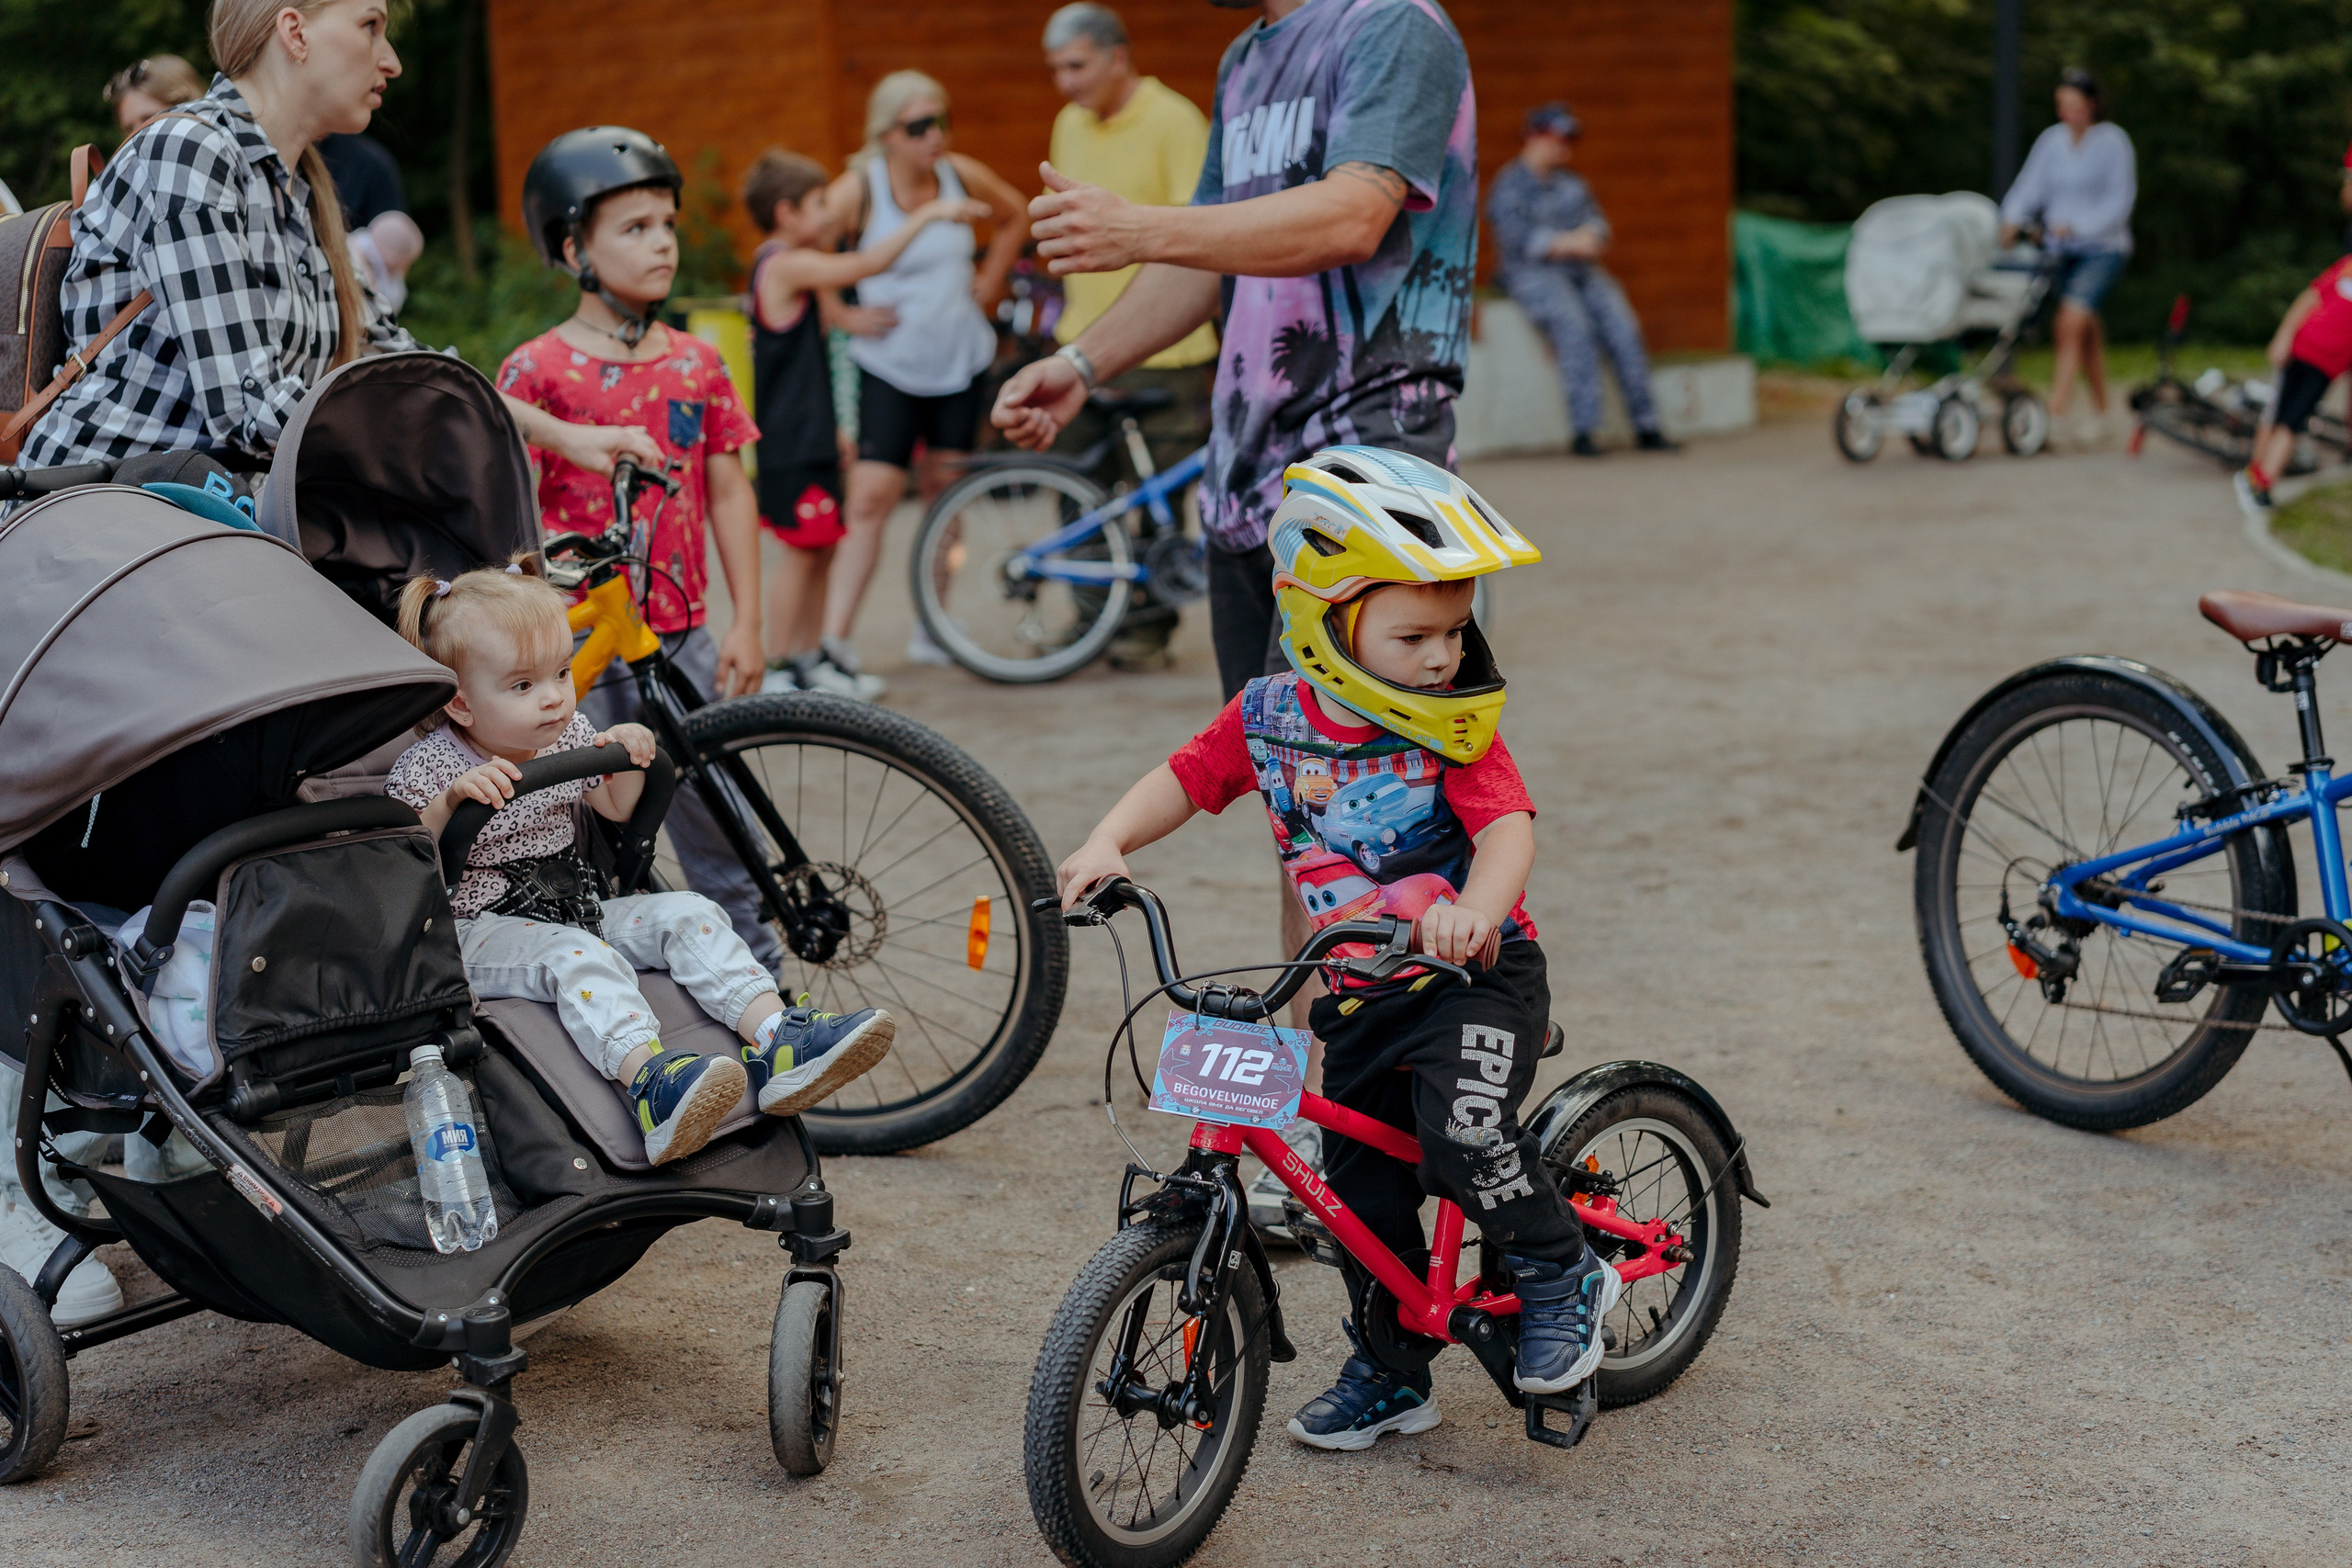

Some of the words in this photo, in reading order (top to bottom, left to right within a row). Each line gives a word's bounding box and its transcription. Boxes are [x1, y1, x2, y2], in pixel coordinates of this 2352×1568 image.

[1198, 1043, 1274, 1086] 112
[1173, 1082, 1279, 1110] BEGOVELVIDNOE
[1282, 1151, 1342, 1218] SHULZ
